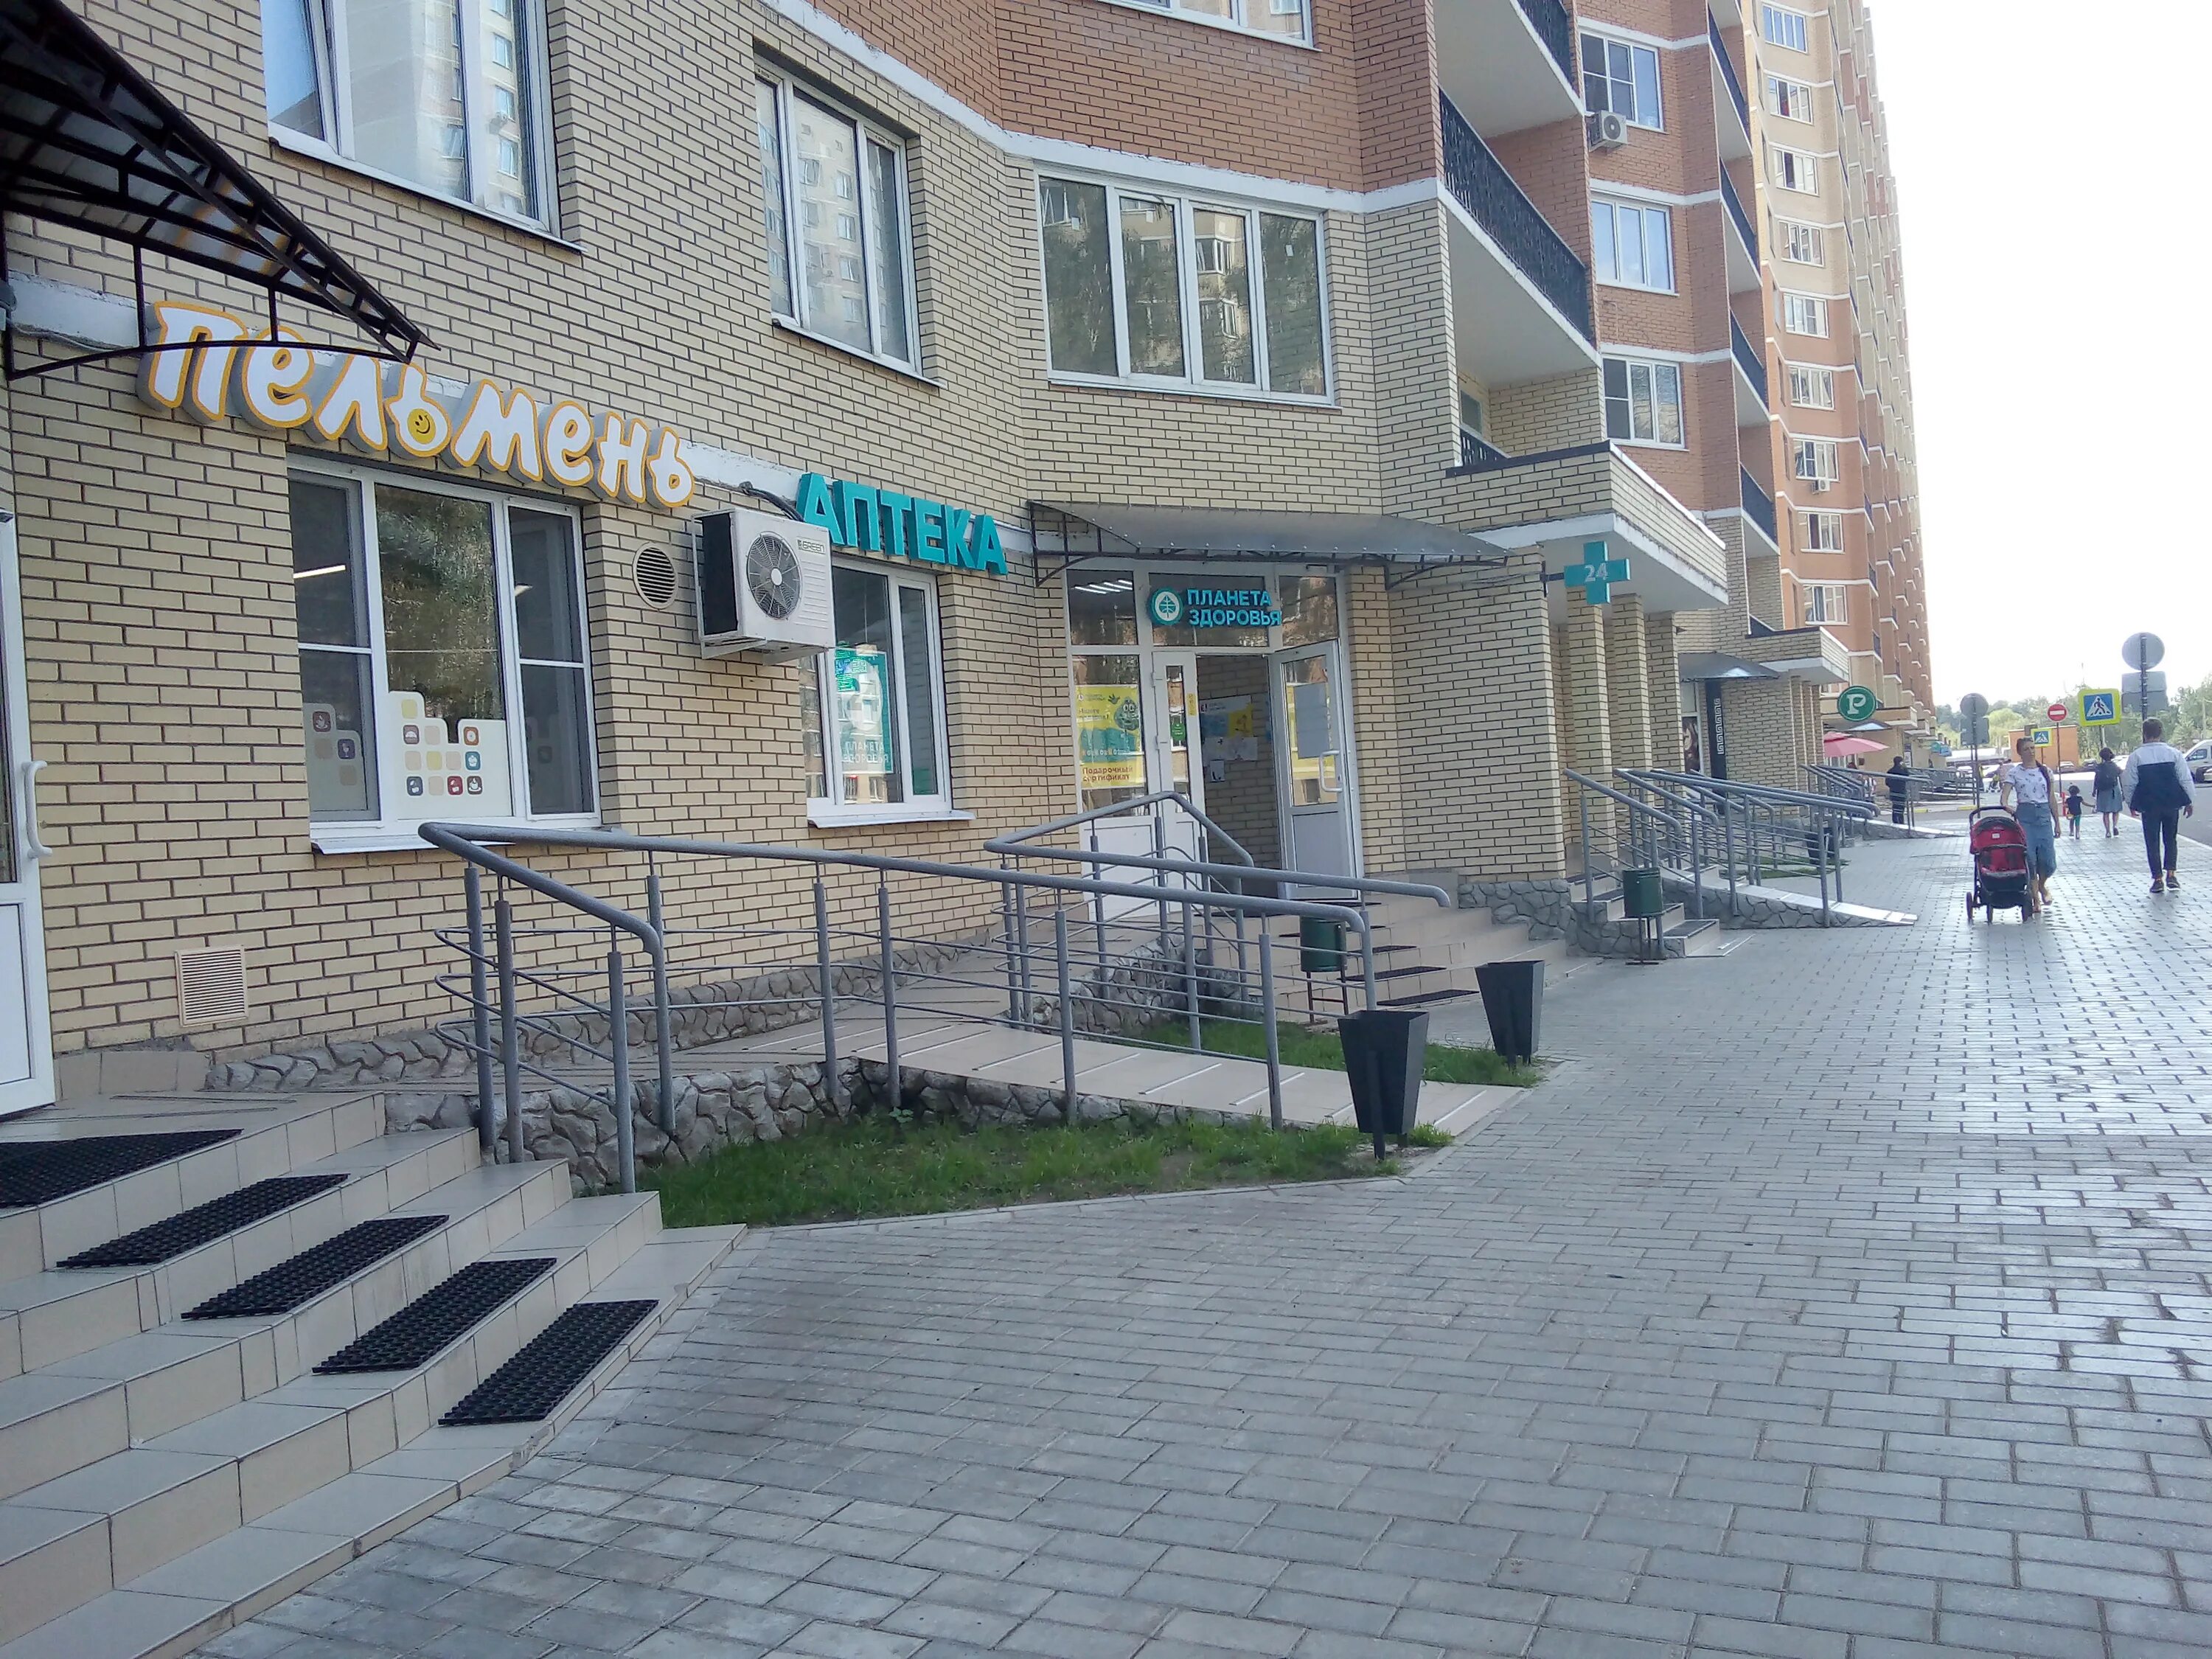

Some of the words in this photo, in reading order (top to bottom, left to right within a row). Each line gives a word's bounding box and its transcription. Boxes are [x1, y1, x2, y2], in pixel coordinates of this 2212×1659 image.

[797, 472, 1008, 575] АПТЕКА
[1584, 563, 1608, 582] 24
[1187, 588, 1273, 607] ПЛАНЕТА
[1189, 609, 1282, 627] ЗДОРОВЬЯ
